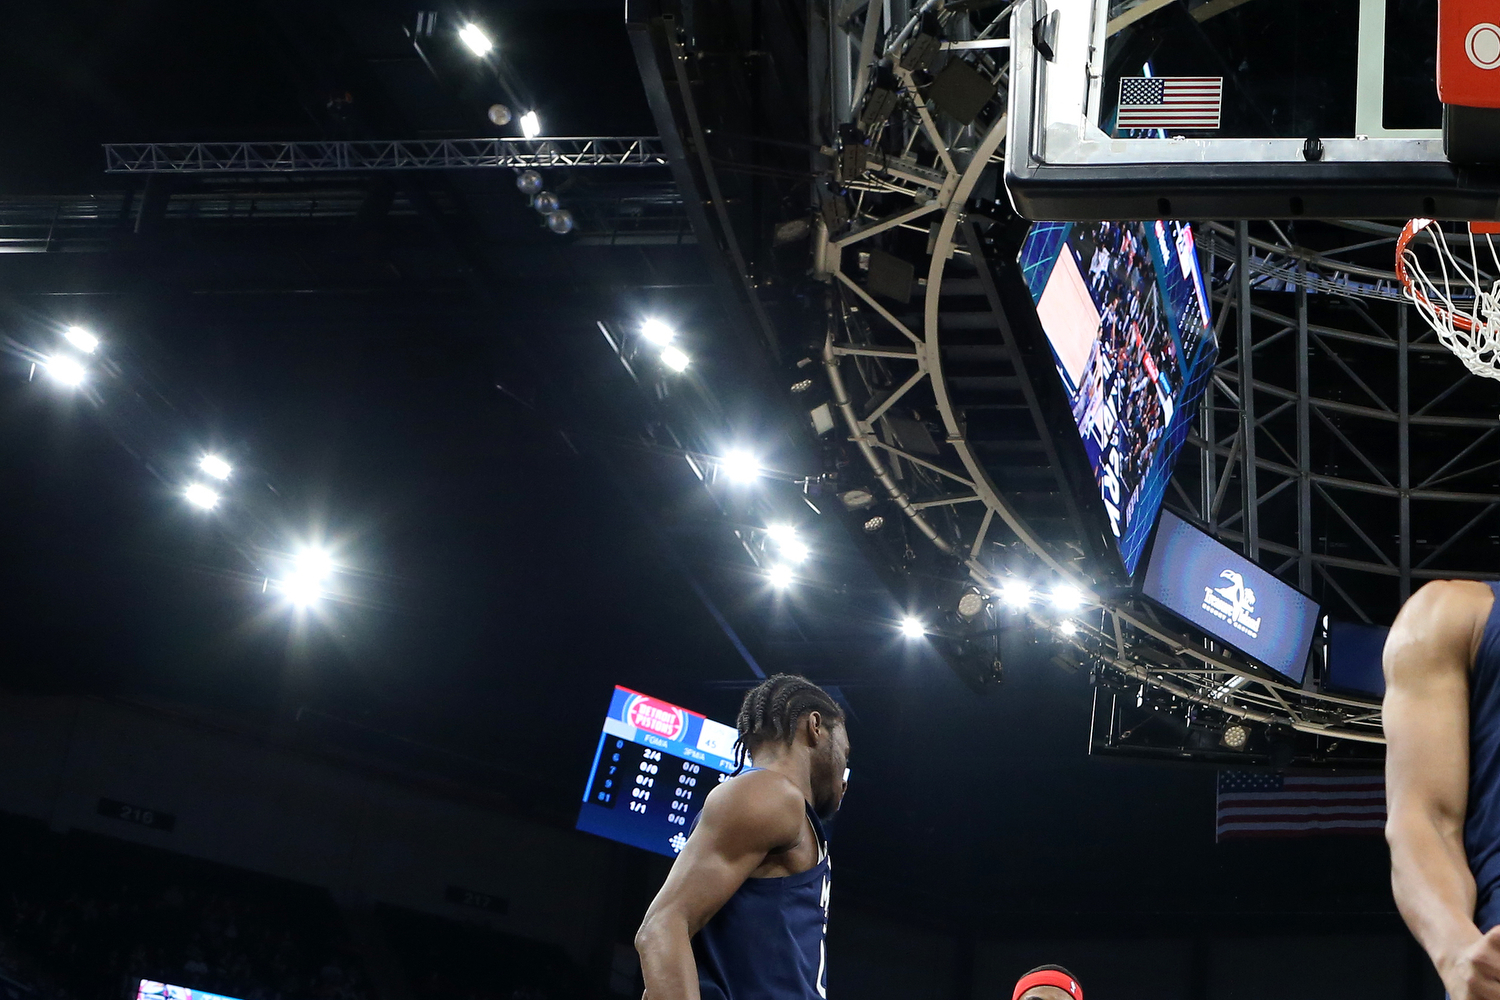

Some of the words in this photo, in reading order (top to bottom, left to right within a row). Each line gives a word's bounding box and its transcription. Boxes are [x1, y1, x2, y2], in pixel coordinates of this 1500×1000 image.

[635, 715, 674, 735] PISTONS
[638, 704, 677, 727] DETROIT
[639, 761, 658, 775] 0/0
[679, 774, 696, 787] 0/0
[643, 749, 661, 762] 2/4
[682, 762, 700, 774] 0/0
[636, 775, 654, 788] 0/1
[675, 787, 692, 800] 0/1
[629, 801, 647, 814] 1/1
[668, 813, 685, 825] 0/0
[632, 788, 650, 801] 0/1
[672, 800, 688, 813] 0/1
